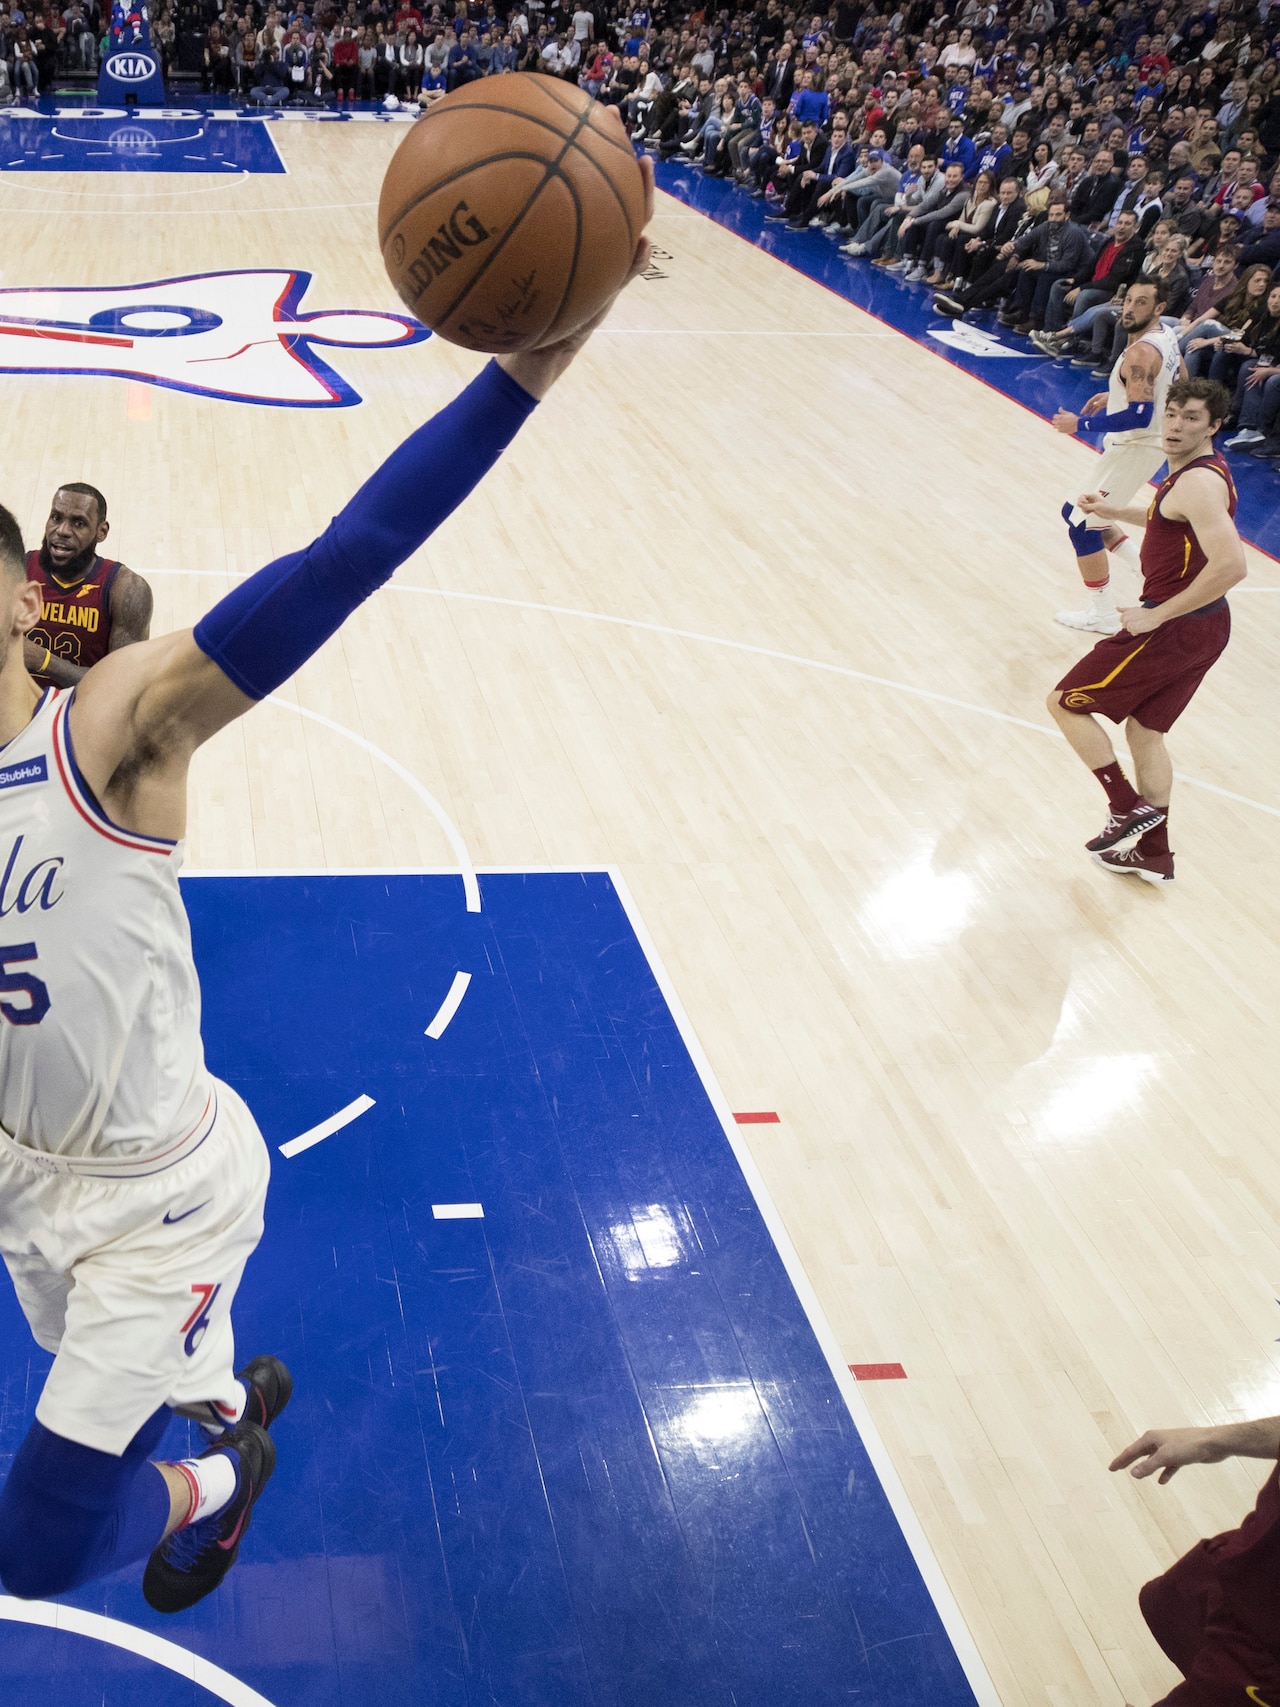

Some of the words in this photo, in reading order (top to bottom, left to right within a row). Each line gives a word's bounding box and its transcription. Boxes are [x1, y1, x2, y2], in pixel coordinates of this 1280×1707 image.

[114, 58, 148, 76] KIA
[397, 200, 491, 300] LDING
[40, 600, 100, 633] VELAND
[180, 1283, 222, 1358] 76
